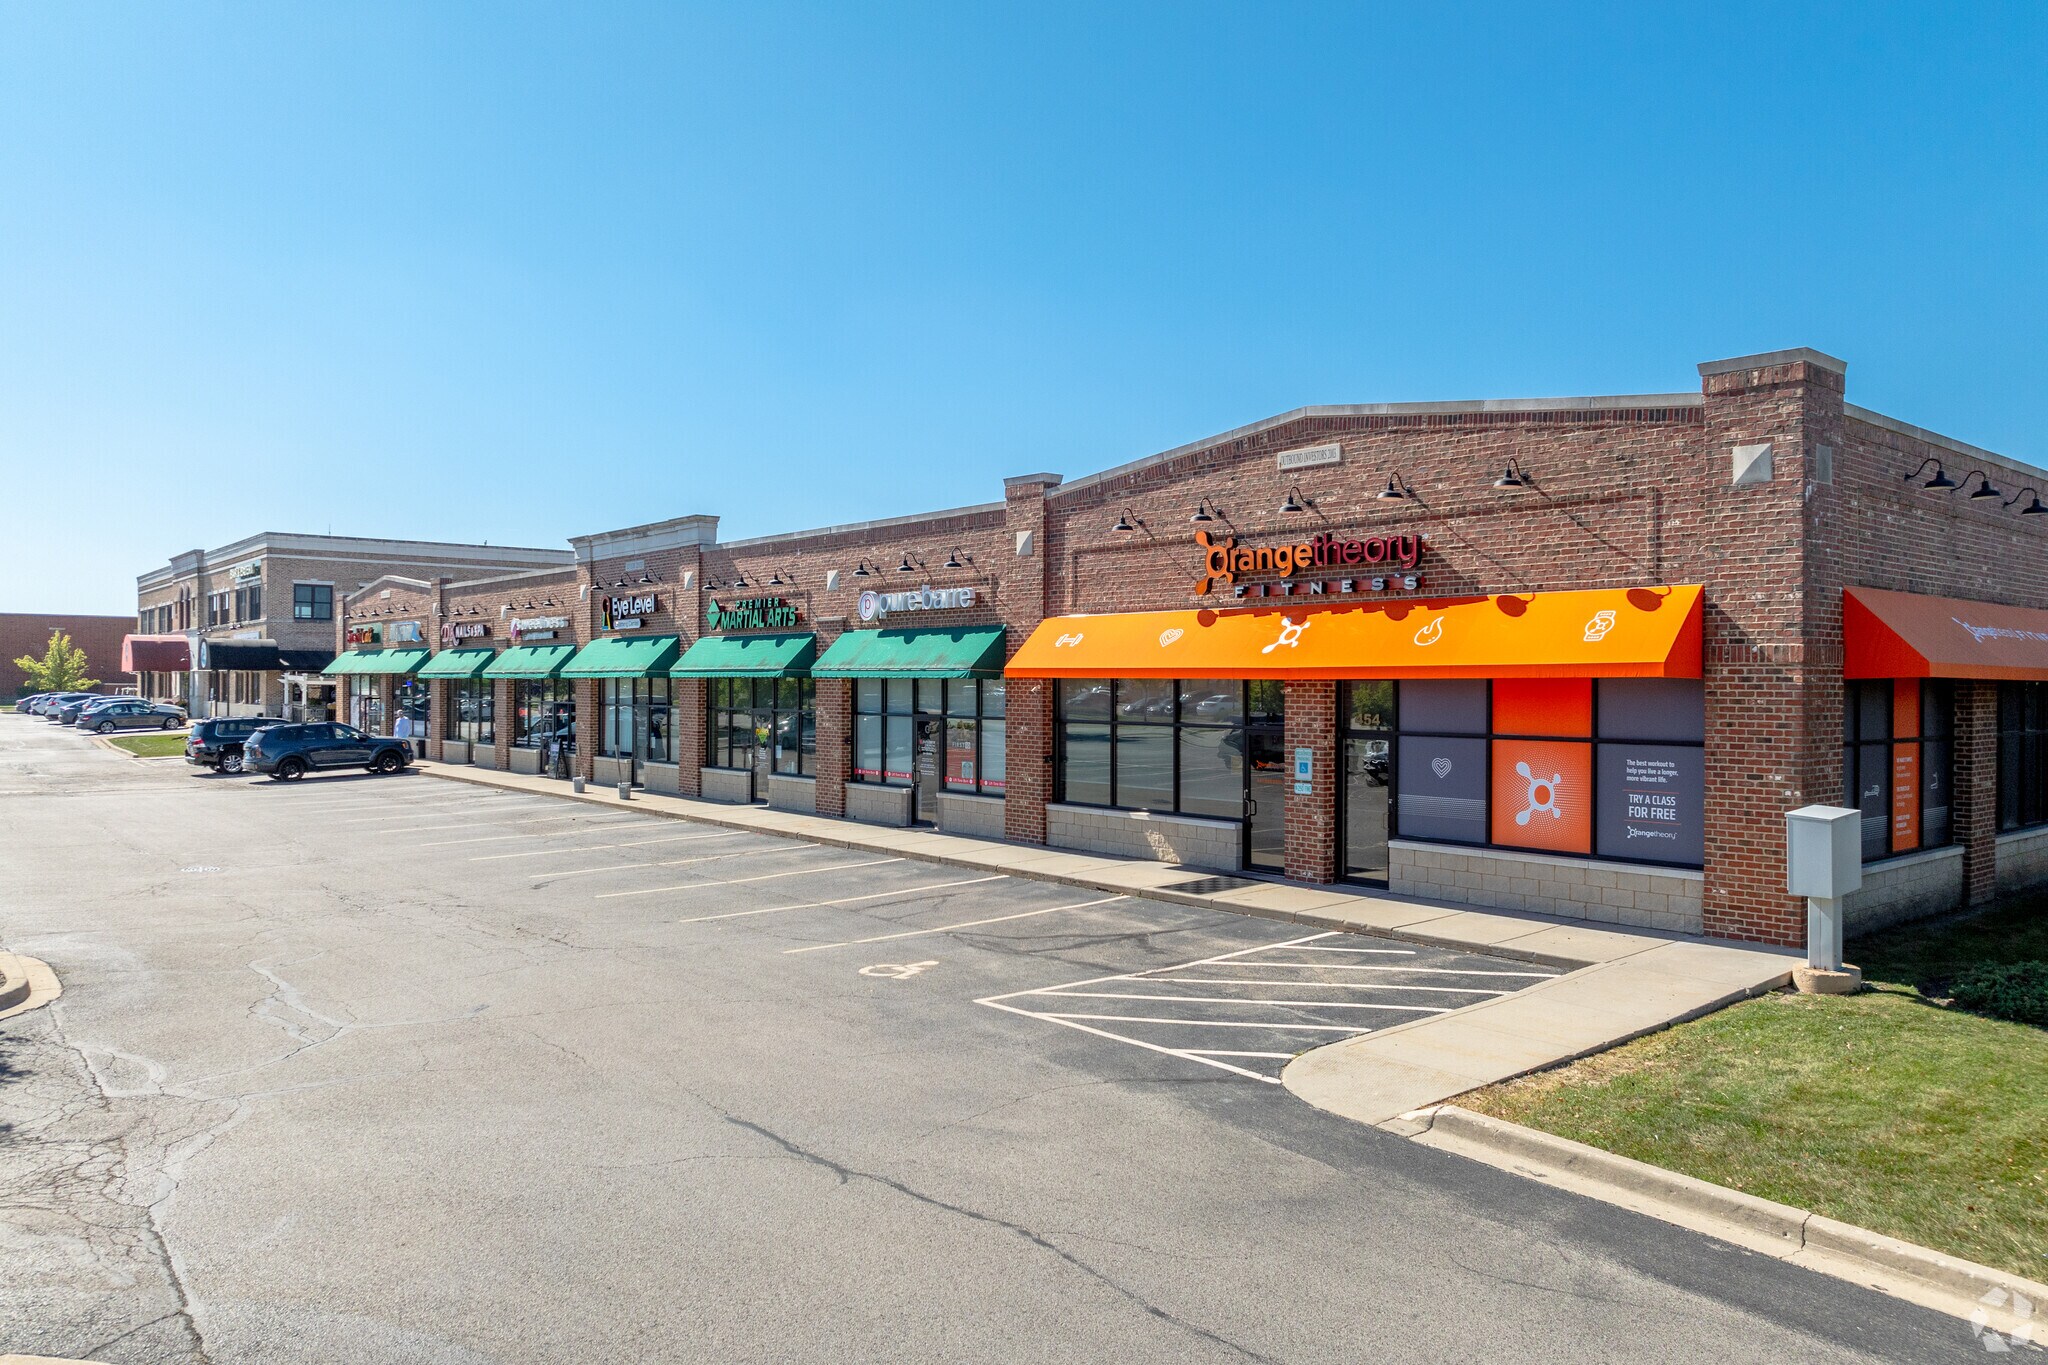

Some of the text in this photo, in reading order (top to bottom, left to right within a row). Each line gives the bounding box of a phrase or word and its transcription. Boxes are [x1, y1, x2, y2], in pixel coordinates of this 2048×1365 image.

[1235, 575, 1418, 598] FITNESS
[612, 593, 655, 619] Eye Level
[735, 597, 779, 609] PREMIER
[879, 584, 976, 618] pure barre
[721, 607, 796, 629] MARTIAL ARTS
[1354, 713, 1381, 726] 454
[1626, 767, 1637, 775] help
[1628, 793, 1676, 806] TRY A CLASS
[1628, 806, 1676, 820] FOR FREE
